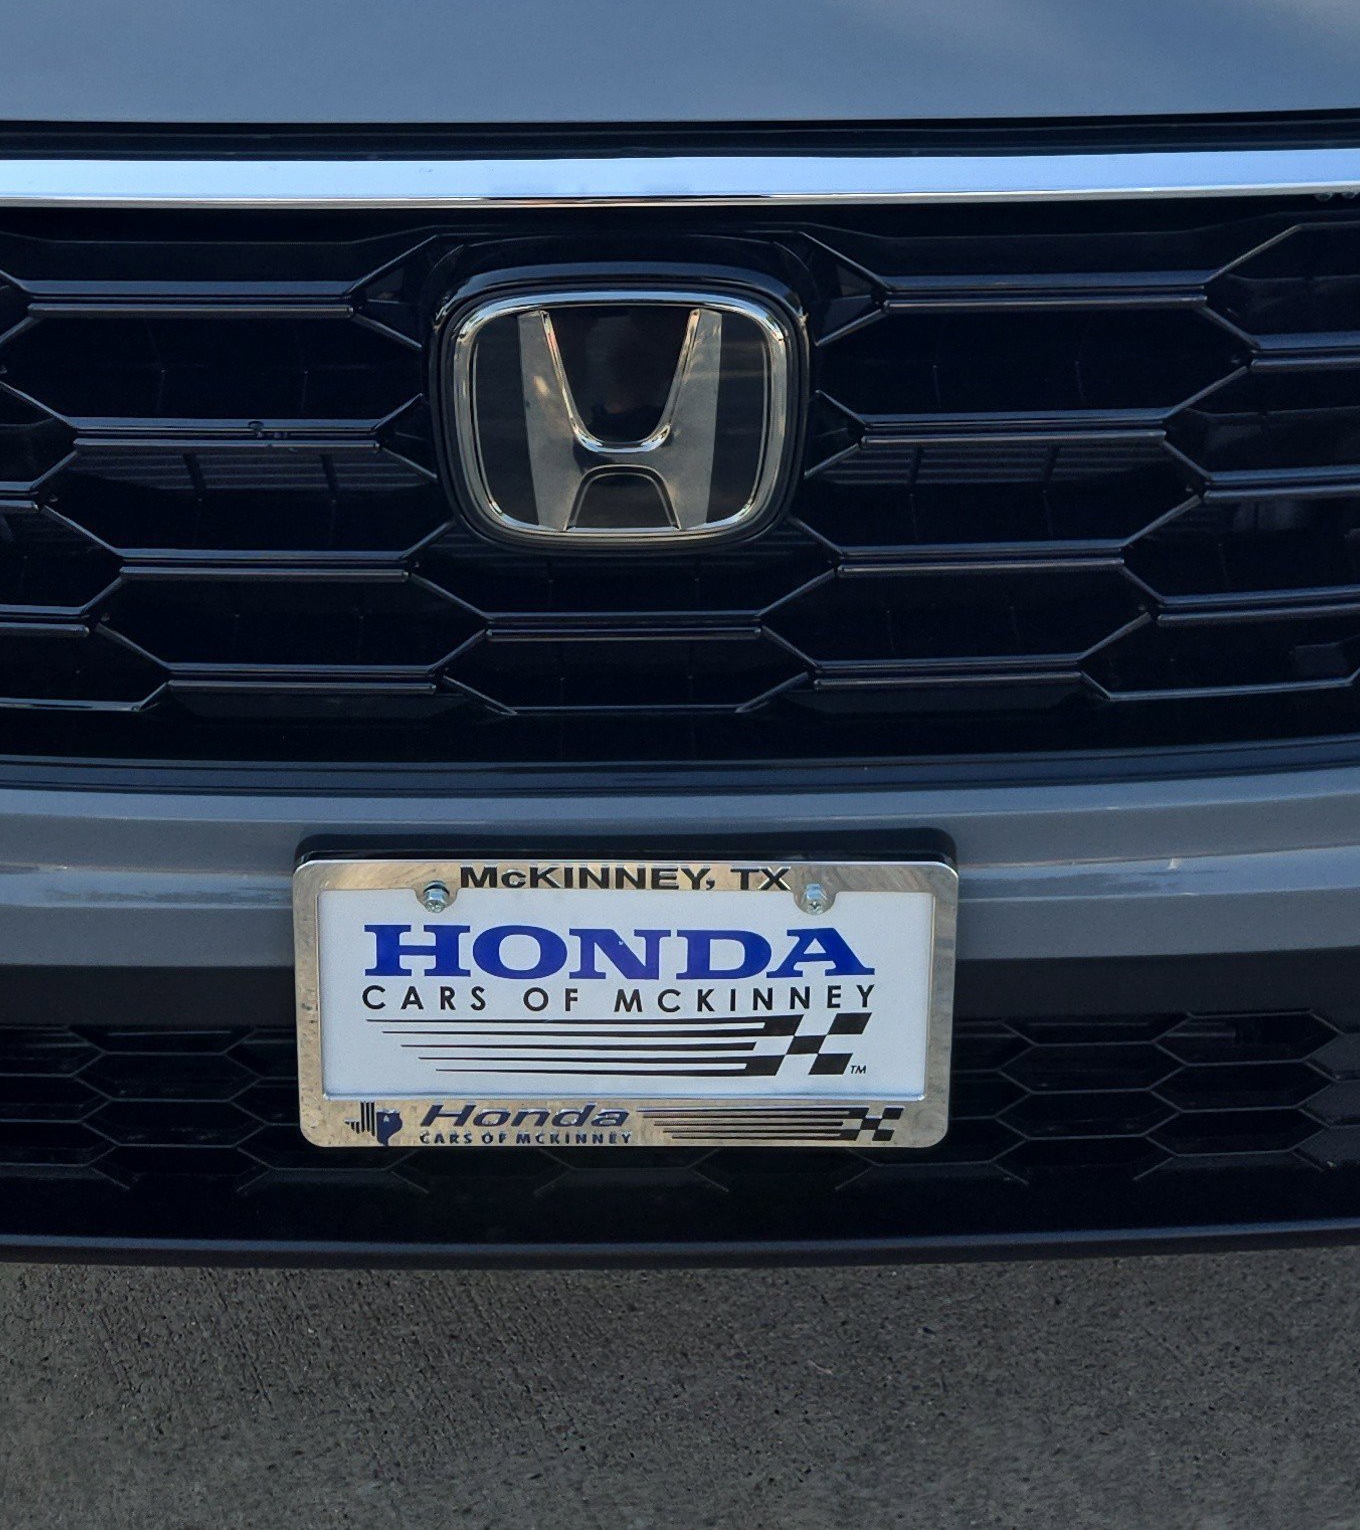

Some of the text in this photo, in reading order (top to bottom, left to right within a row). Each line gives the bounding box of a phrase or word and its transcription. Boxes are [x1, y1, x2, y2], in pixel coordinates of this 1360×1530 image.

[459, 865, 791, 891] McKINNEY, TX
[363, 923, 876, 981] HONDA
[361, 983, 876, 1013] CARS OF MCKINNEY
[419, 1102, 630, 1128] Honda
[419, 1131, 633, 1145] CARS OF MCKINNEY
